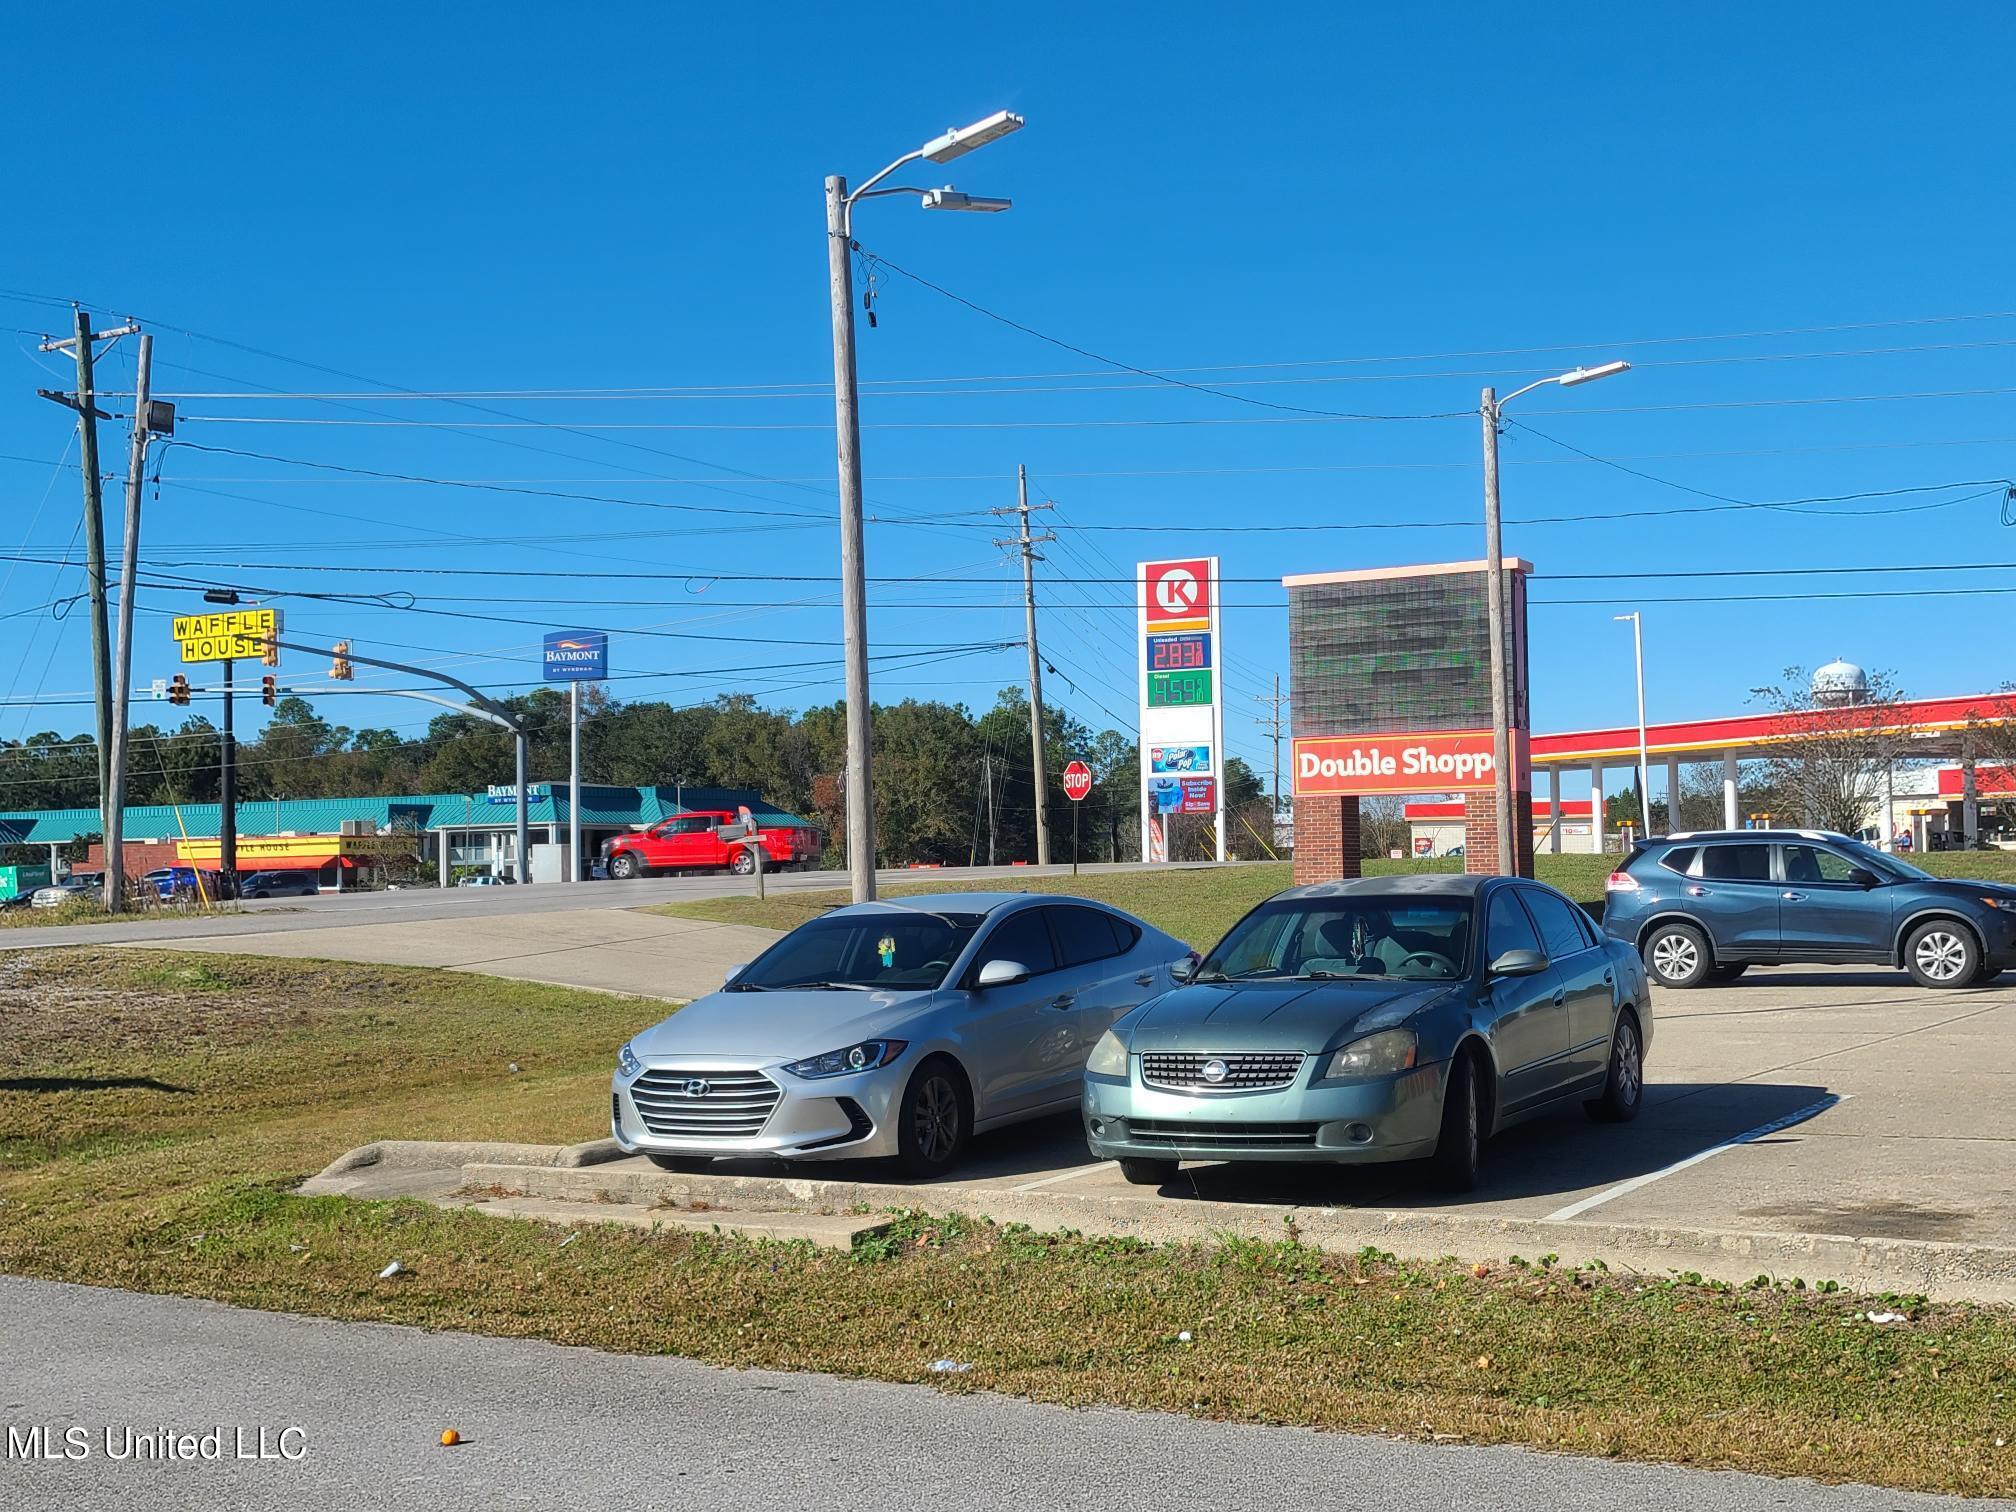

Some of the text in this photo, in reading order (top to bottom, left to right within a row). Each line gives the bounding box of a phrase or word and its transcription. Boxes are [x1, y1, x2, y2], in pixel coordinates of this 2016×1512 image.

[175, 613, 271, 636] WAFFLE
[185, 637, 262, 659] HOUSE
[1154, 642, 1195, 668] 2.83
[545, 650, 600, 662] BAYMONT
[1155, 679, 1195, 703] 4.59
[1168, 749, 1187, 762] Polar
[1299, 746, 1496, 780] Double Shopp
[1177, 758, 1193, 770] Pop
[1065, 773, 1089, 788] STOP
[487, 784, 539, 797] BAYMNT
[260, 843, 289, 851] HOUSE
